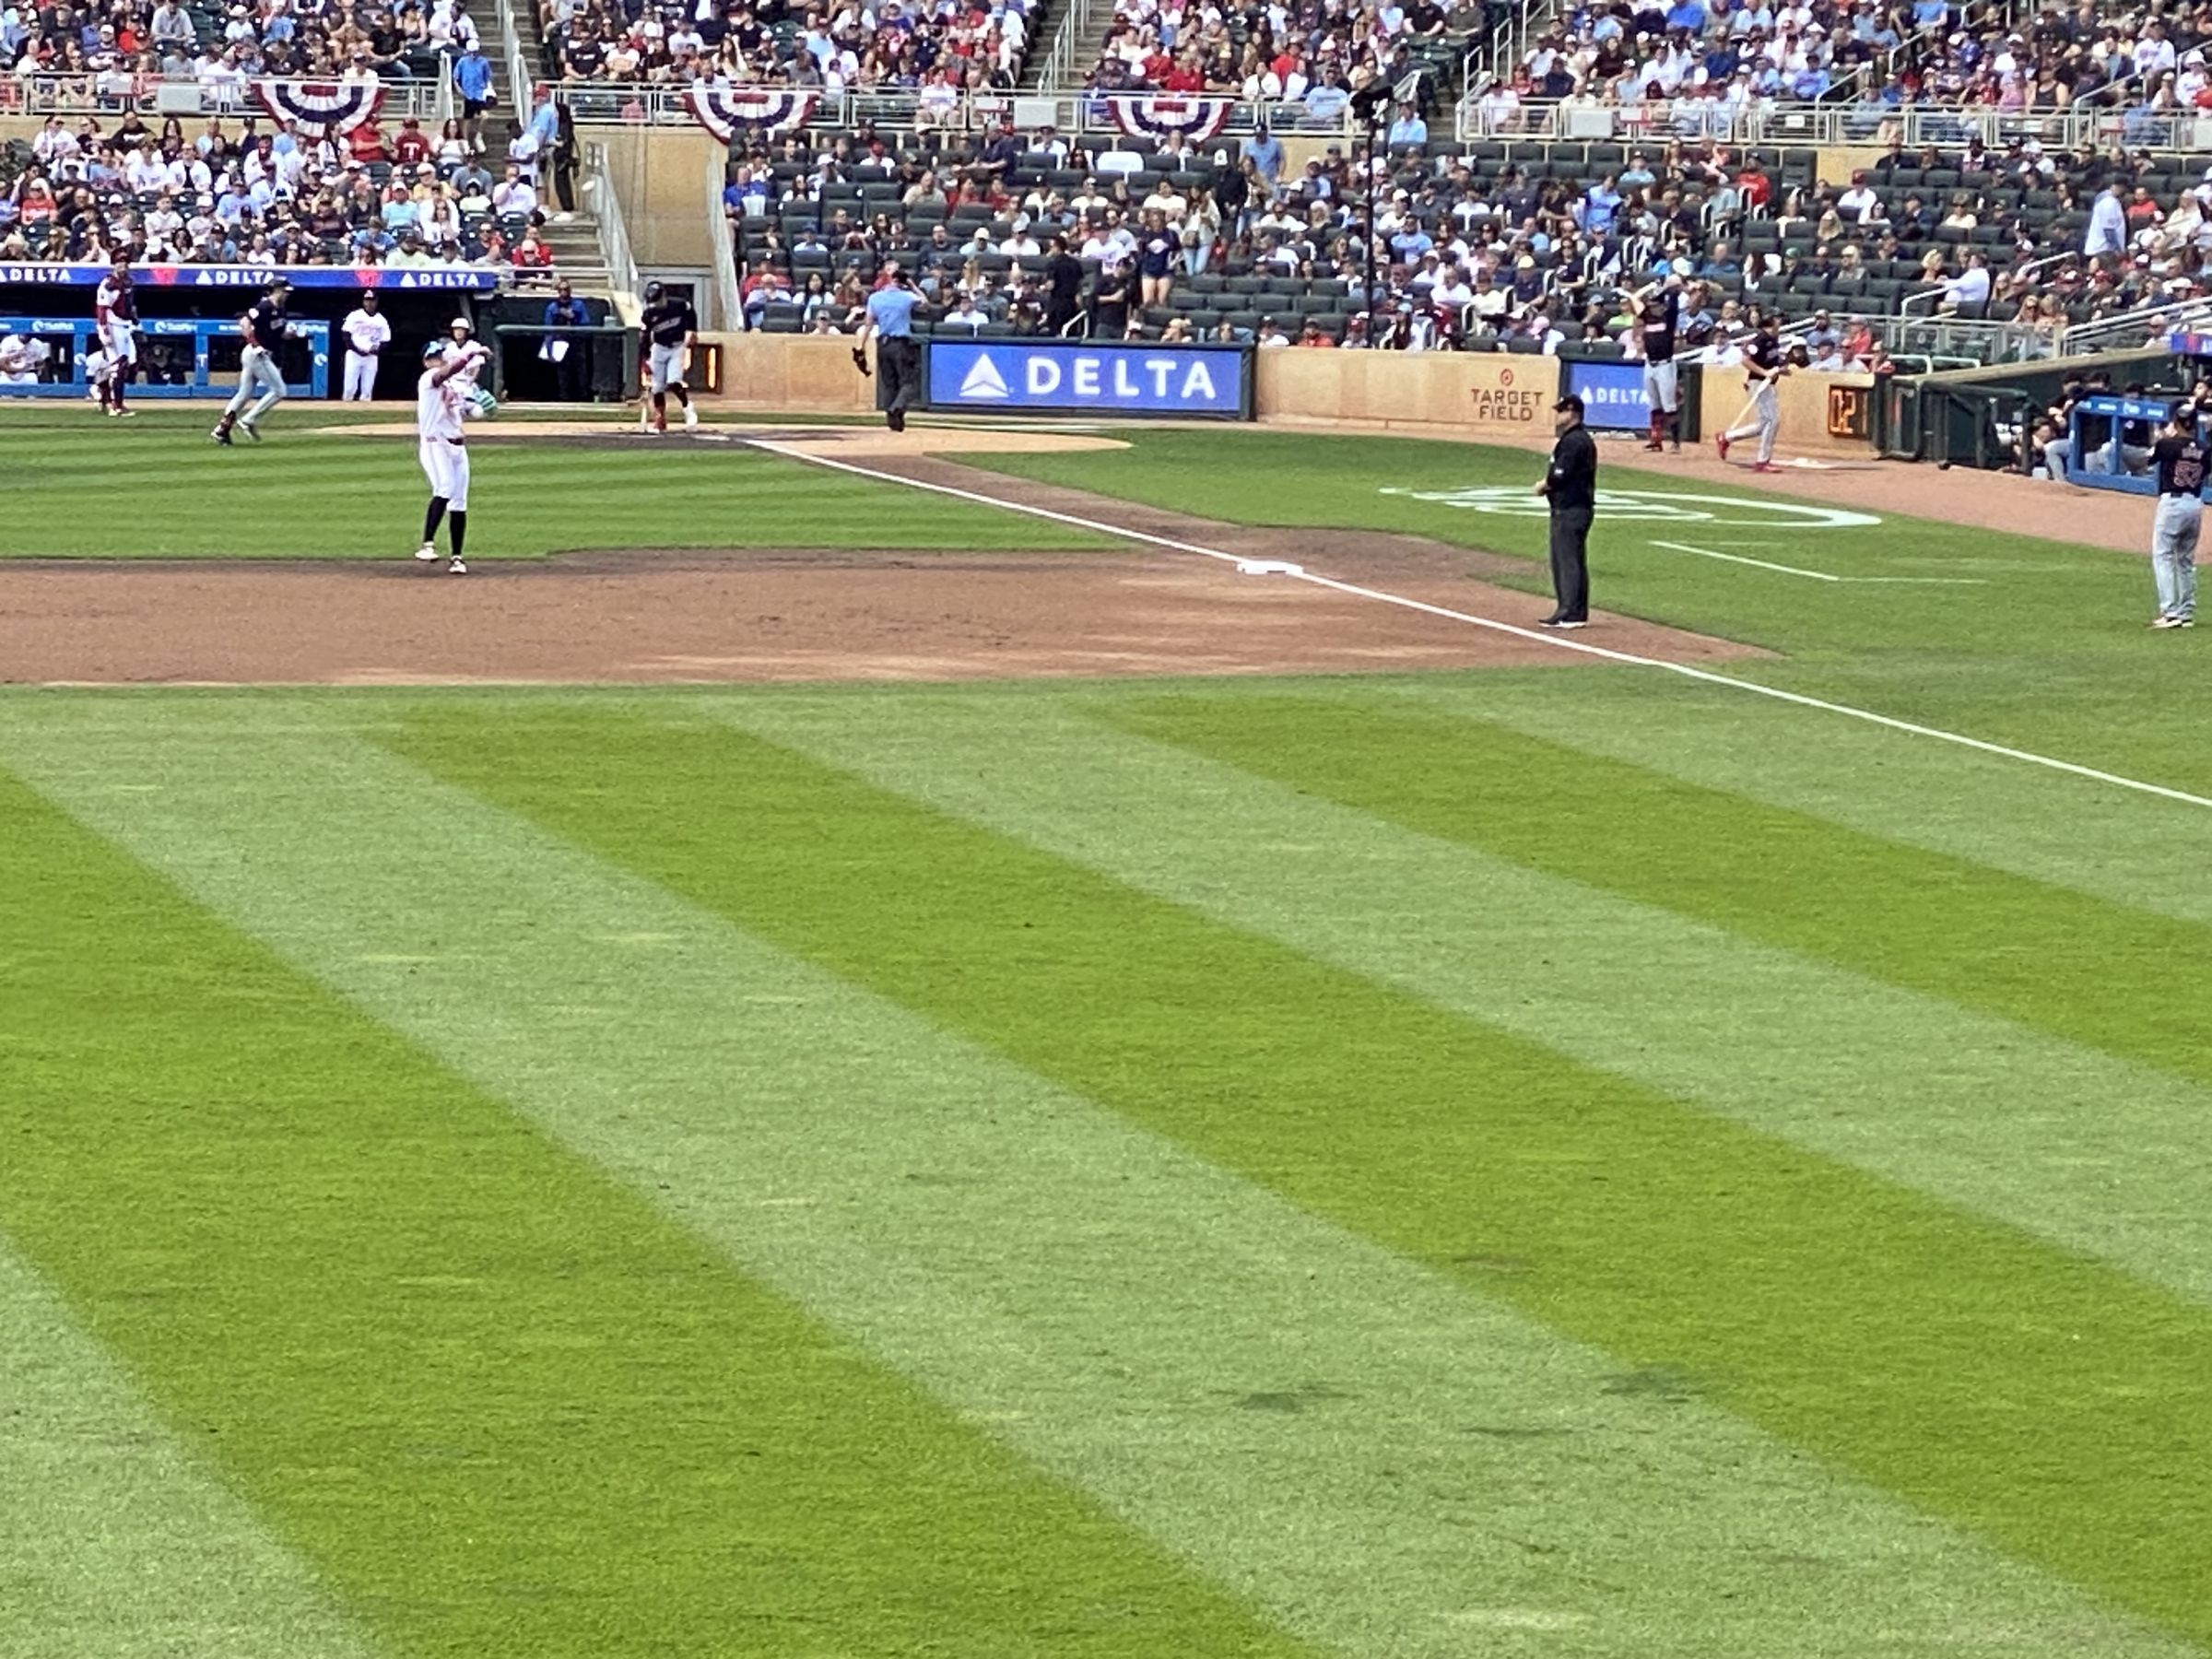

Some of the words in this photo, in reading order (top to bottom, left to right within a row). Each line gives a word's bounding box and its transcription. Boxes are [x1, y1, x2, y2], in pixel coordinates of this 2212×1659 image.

[9, 268, 72, 282] DELTA
[419, 273, 479, 287] DELTA
[1026, 357, 1217, 399] DELTA
[1471, 388, 1544, 406] TARGET
[1595, 386, 1651, 405] DELTA
[1478, 405, 1534, 421] FIELD
